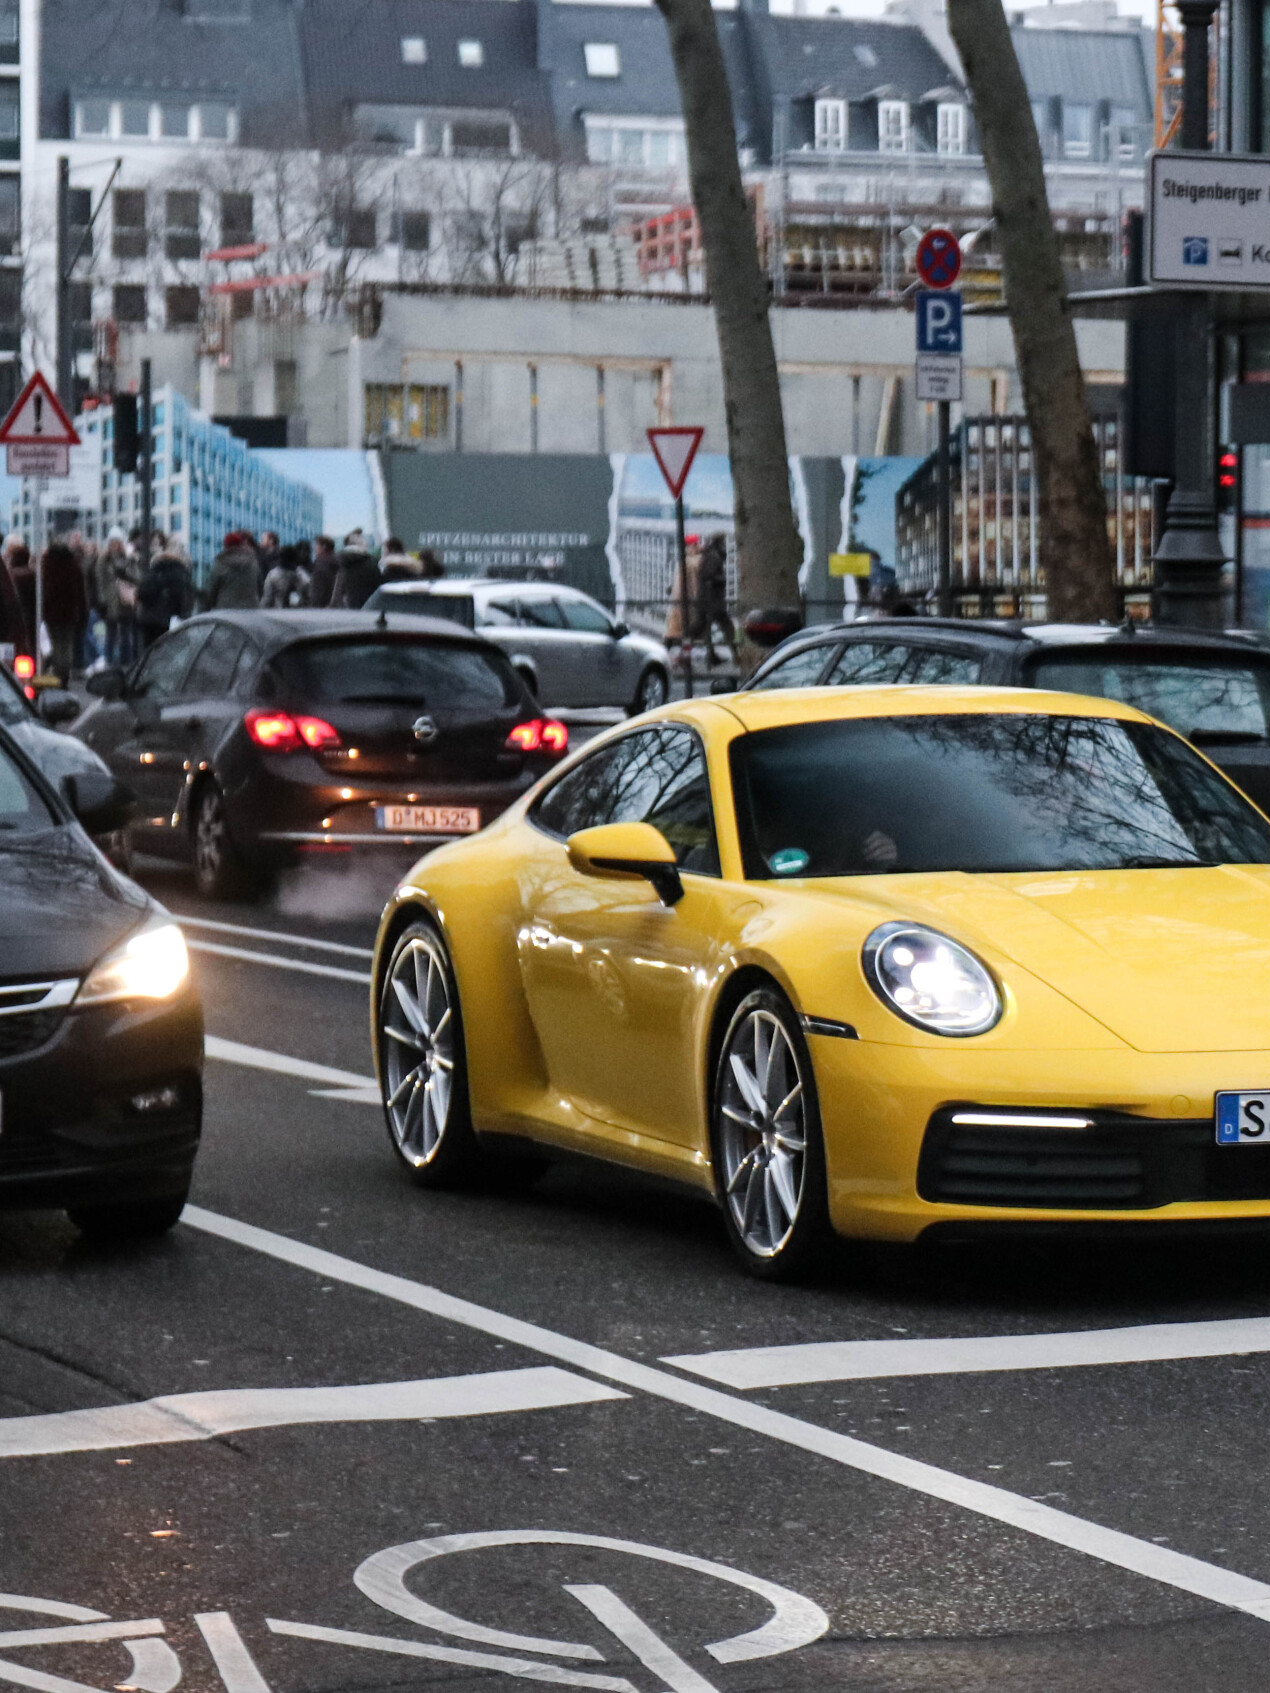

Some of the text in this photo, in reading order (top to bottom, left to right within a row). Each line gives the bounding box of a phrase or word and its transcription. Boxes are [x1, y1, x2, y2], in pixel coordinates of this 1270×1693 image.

[1162, 179, 1262, 206] Steigenberger
[926, 299, 951, 345] P
[440, 809, 471, 827] 525
[1240, 1099, 1265, 1137] S
